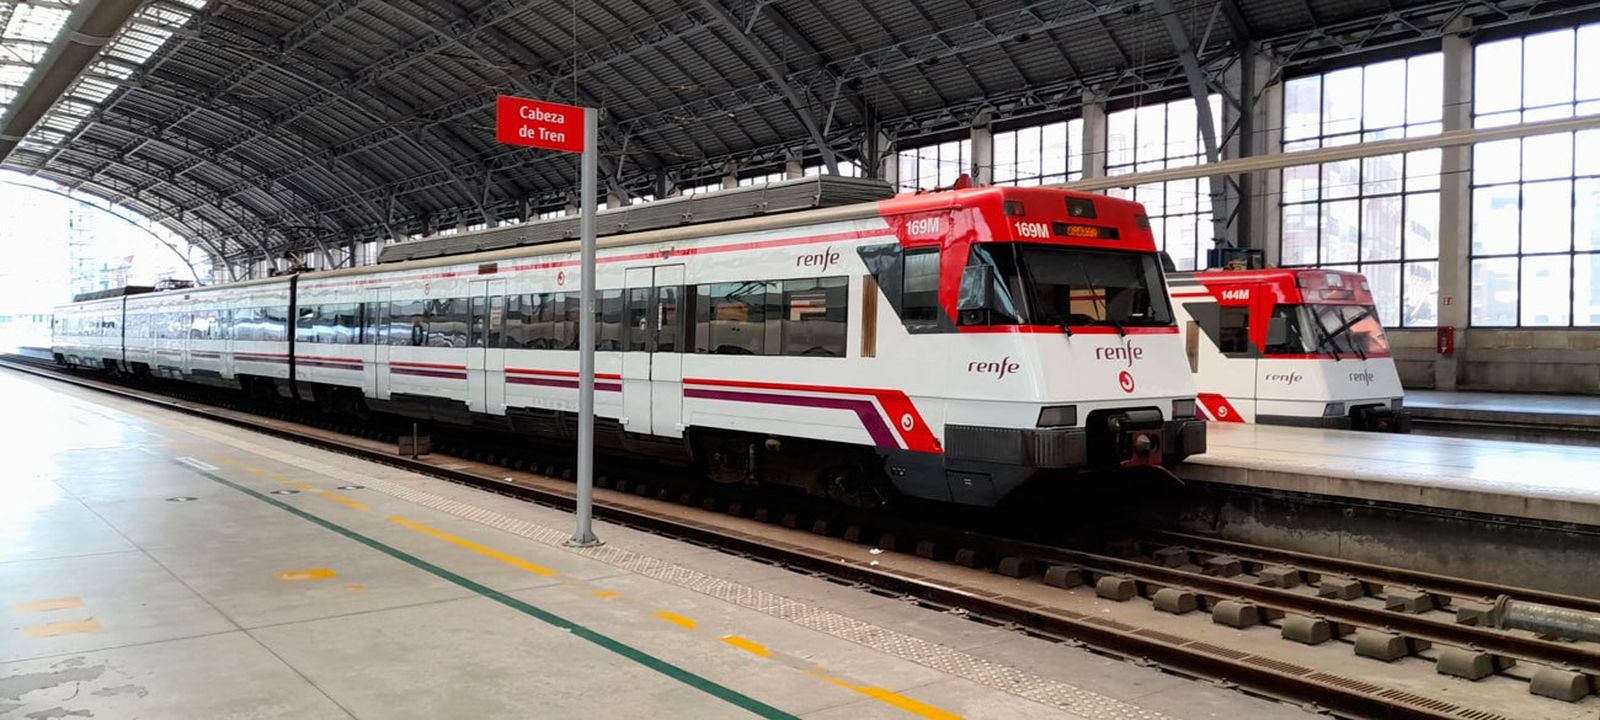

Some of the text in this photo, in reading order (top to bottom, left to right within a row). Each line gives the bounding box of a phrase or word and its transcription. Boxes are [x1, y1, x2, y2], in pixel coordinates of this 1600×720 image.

[519, 105, 565, 124] Cabeza
[518, 124, 566, 143] de Tren
[905, 219, 939, 235] 169M
[1014, 221, 1050, 239] 169M
[796, 246, 840, 272] renfe
[1221, 289, 1249, 300] 144M
[1095, 339, 1143, 368] renfe
[967, 356, 1020, 380] renfe
[1348, 369, 1374, 385] renfe
[1265, 371, 1303, 385] renfe
